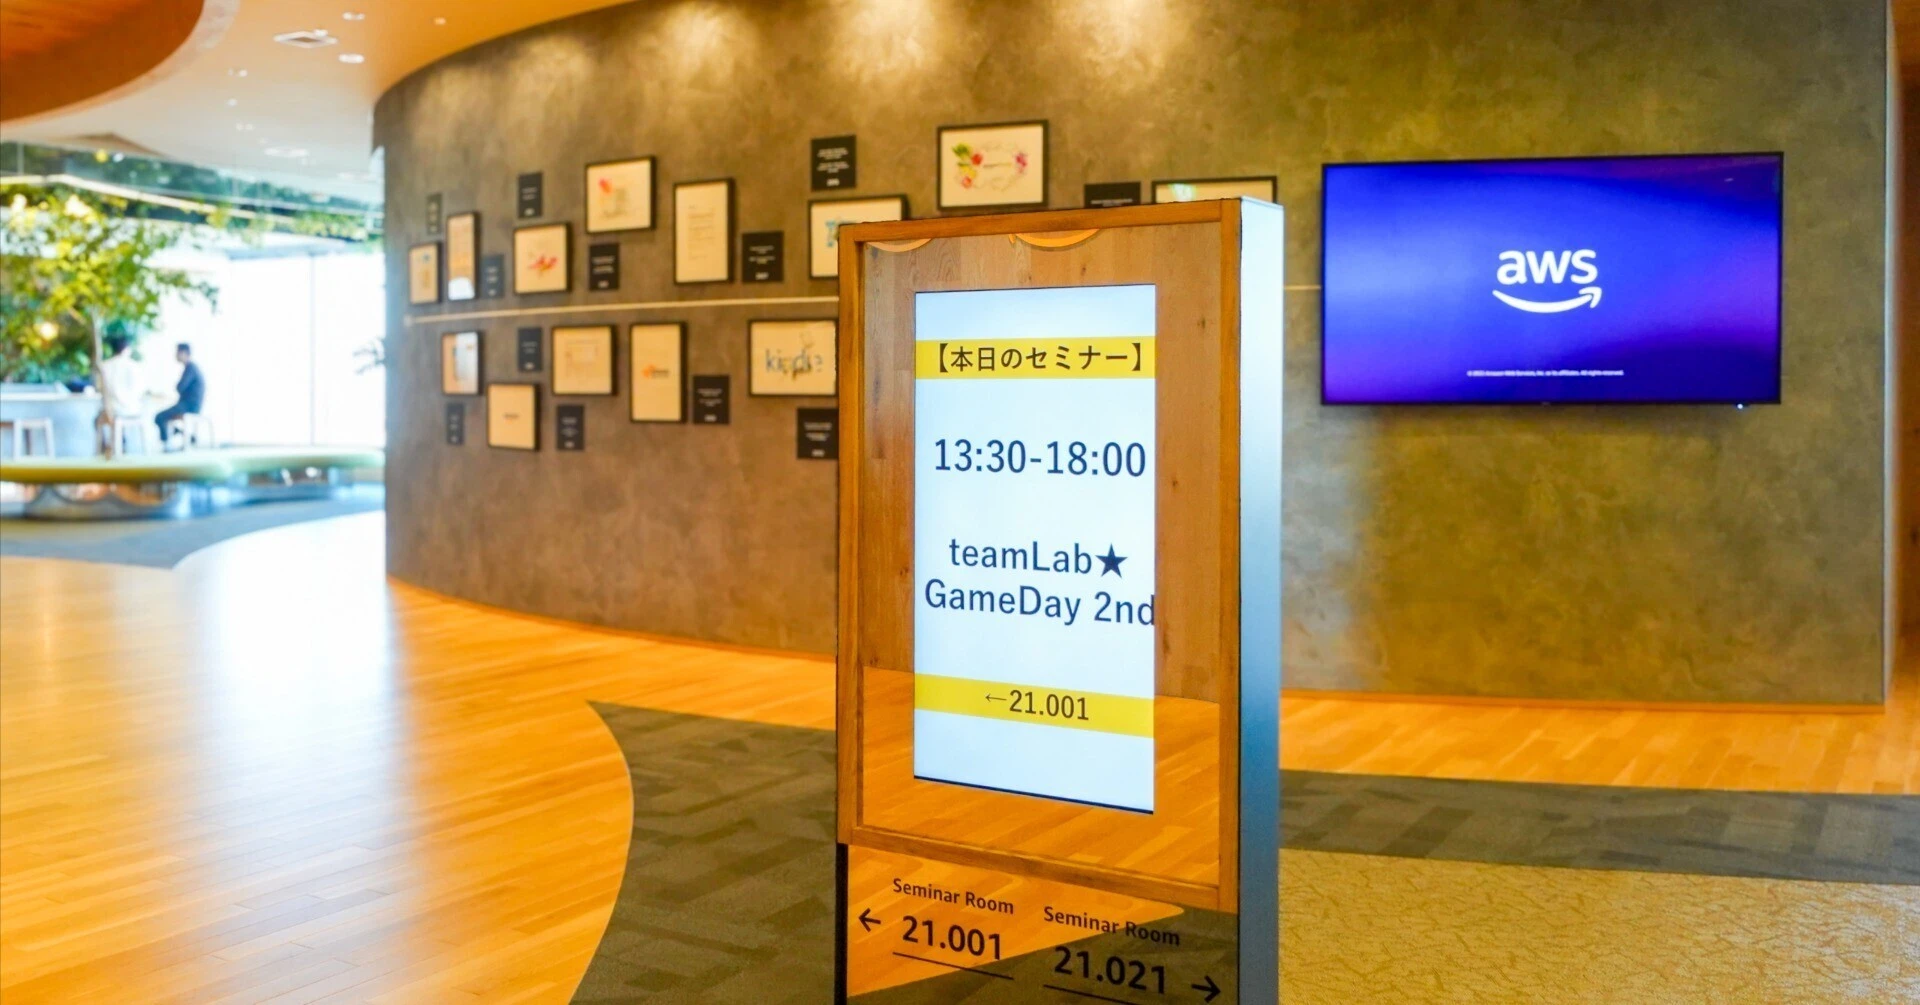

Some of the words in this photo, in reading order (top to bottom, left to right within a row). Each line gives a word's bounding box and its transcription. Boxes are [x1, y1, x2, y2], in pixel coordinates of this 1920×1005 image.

[1497, 249, 1598, 285] aws
[939, 342, 1141, 373] 【本日のセミナー】
[935, 439, 1146, 477] 13:30-18:00
[925, 578, 1081, 626] GameDay
[1094, 591, 1155, 626] 2nd
[892, 878, 960, 904] Seminar
[965, 891, 1014, 915] Room
[902, 916, 1000, 960] 21.001
[1043, 906, 1119, 934] Seminar
[1126, 921, 1180, 946] Room
[1054, 945, 1166, 995] 21.021
